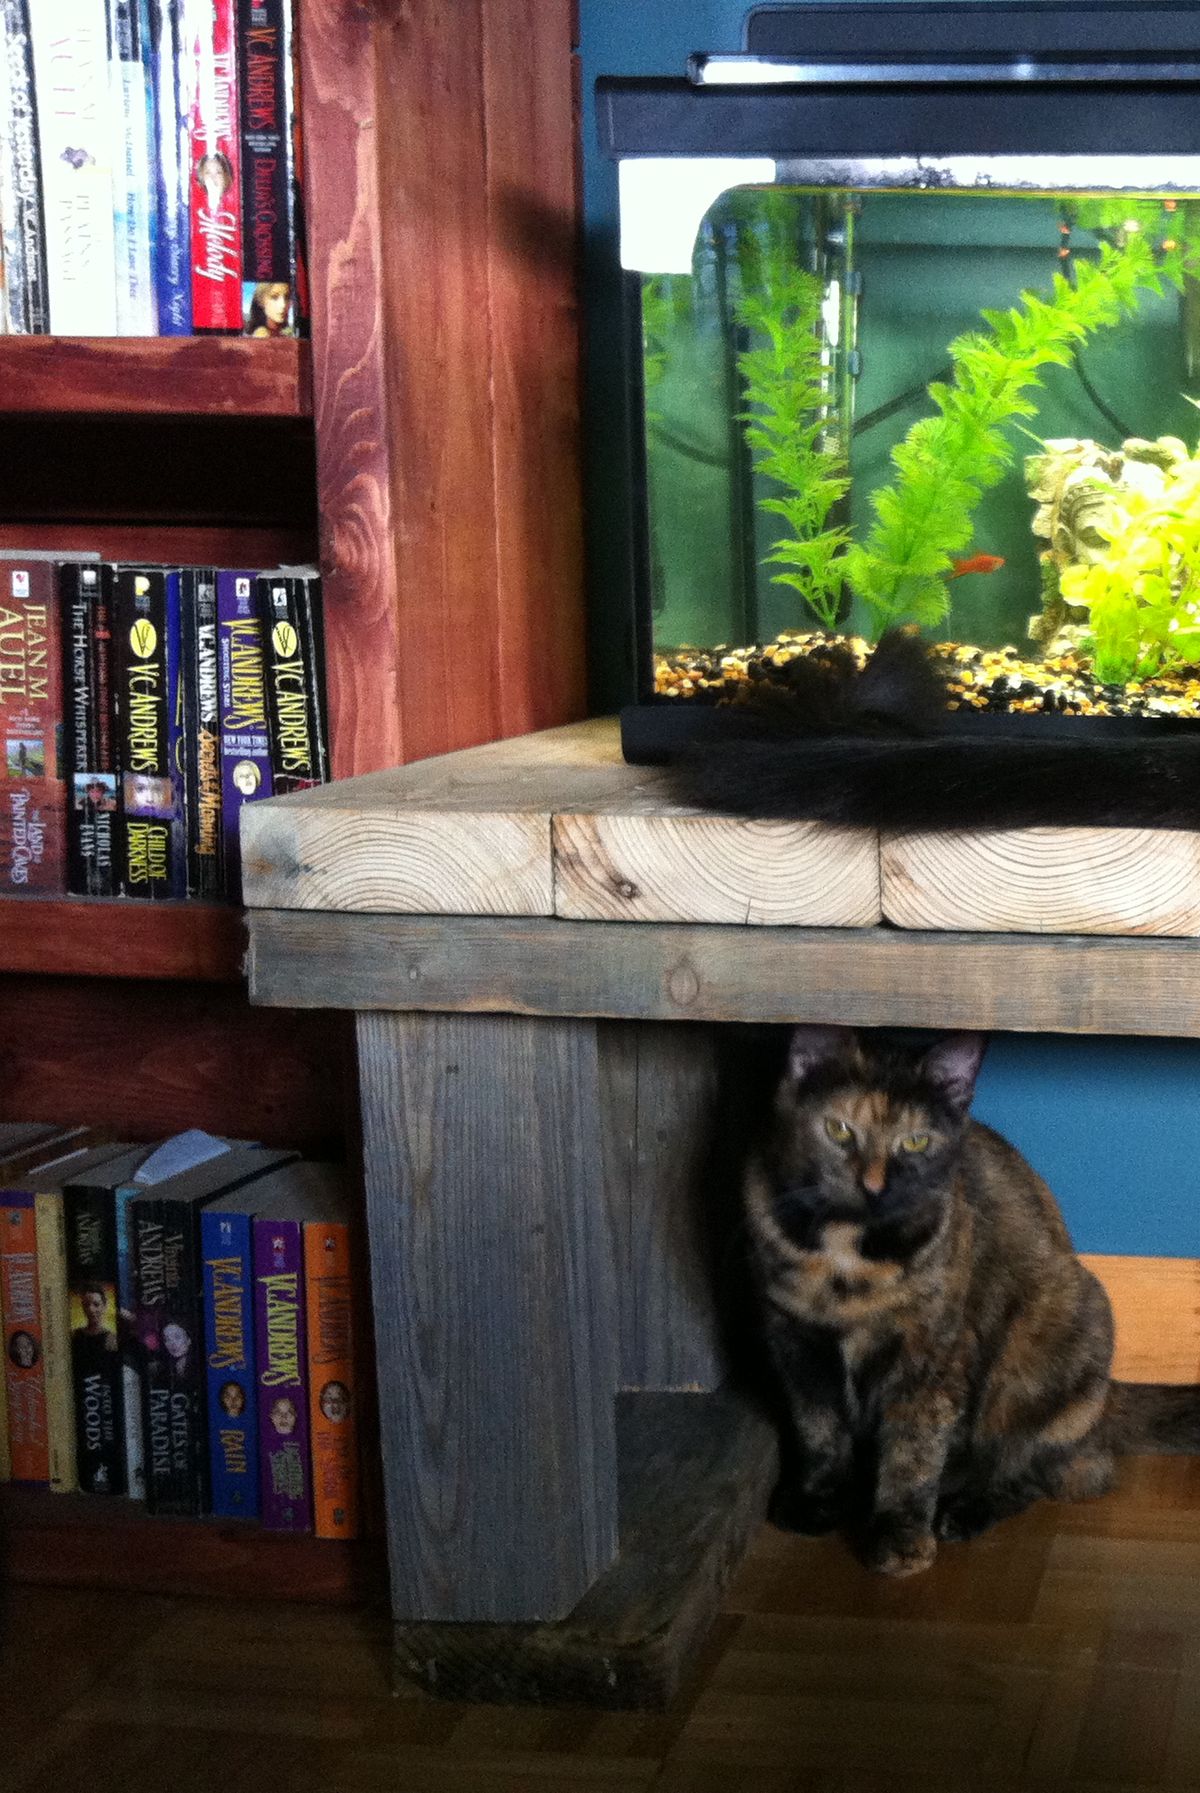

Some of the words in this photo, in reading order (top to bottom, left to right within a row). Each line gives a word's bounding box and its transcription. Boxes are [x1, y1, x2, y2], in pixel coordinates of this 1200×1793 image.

[246, 53, 279, 129] ANDREWS
[25, 228, 38, 282] Andrews
[195, 209, 238, 281] Melody
[254, 210, 277, 278] CROSSING
[169, 290, 186, 326] Night
[24, 604, 48, 673] JEAN
[72, 604, 86, 630] THE
[0, 607, 26, 704] AUEL
[73, 634, 86, 683] HORSE
[220, 638, 232, 682] SHOOTING
[28, 676, 48, 705] M.
[199, 647, 217, 723] ANDREWS
[222, 683, 232, 707] STARS
[223, 643, 268, 729] ANDREWS
[74, 685, 90, 771] WHISPERER
[127, 693, 162, 772] ANDREWS
[274, 691, 311, 771] ANDREWS
[10, 789, 30, 847] PAINTED
[27, 821, 46, 855] LAND
[80, 824, 95, 857] EVANS
[97, 812, 111, 867] NICHOLAS
[147, 826, 168, 862] CHILD
[12, 846, 31, 884] CAVES
[127, 822, 147, 883] DARKNESS
[147, 863, 166, 880] OF
[137, 1219, 165, 1305] ANDREWS
[208, 1281, 247, 1369] ANDREWS
[260, 1296, 302, 1387] ANDREWS
[83, 1373, 103, 1451] WOODS
[149, 1388, 171, 1475] PARADISE
[170, 1392, 188, 1446] GATES
[174, 1450, 188, 1470] OF
[219, 1429, 247, 1473] RAIN
